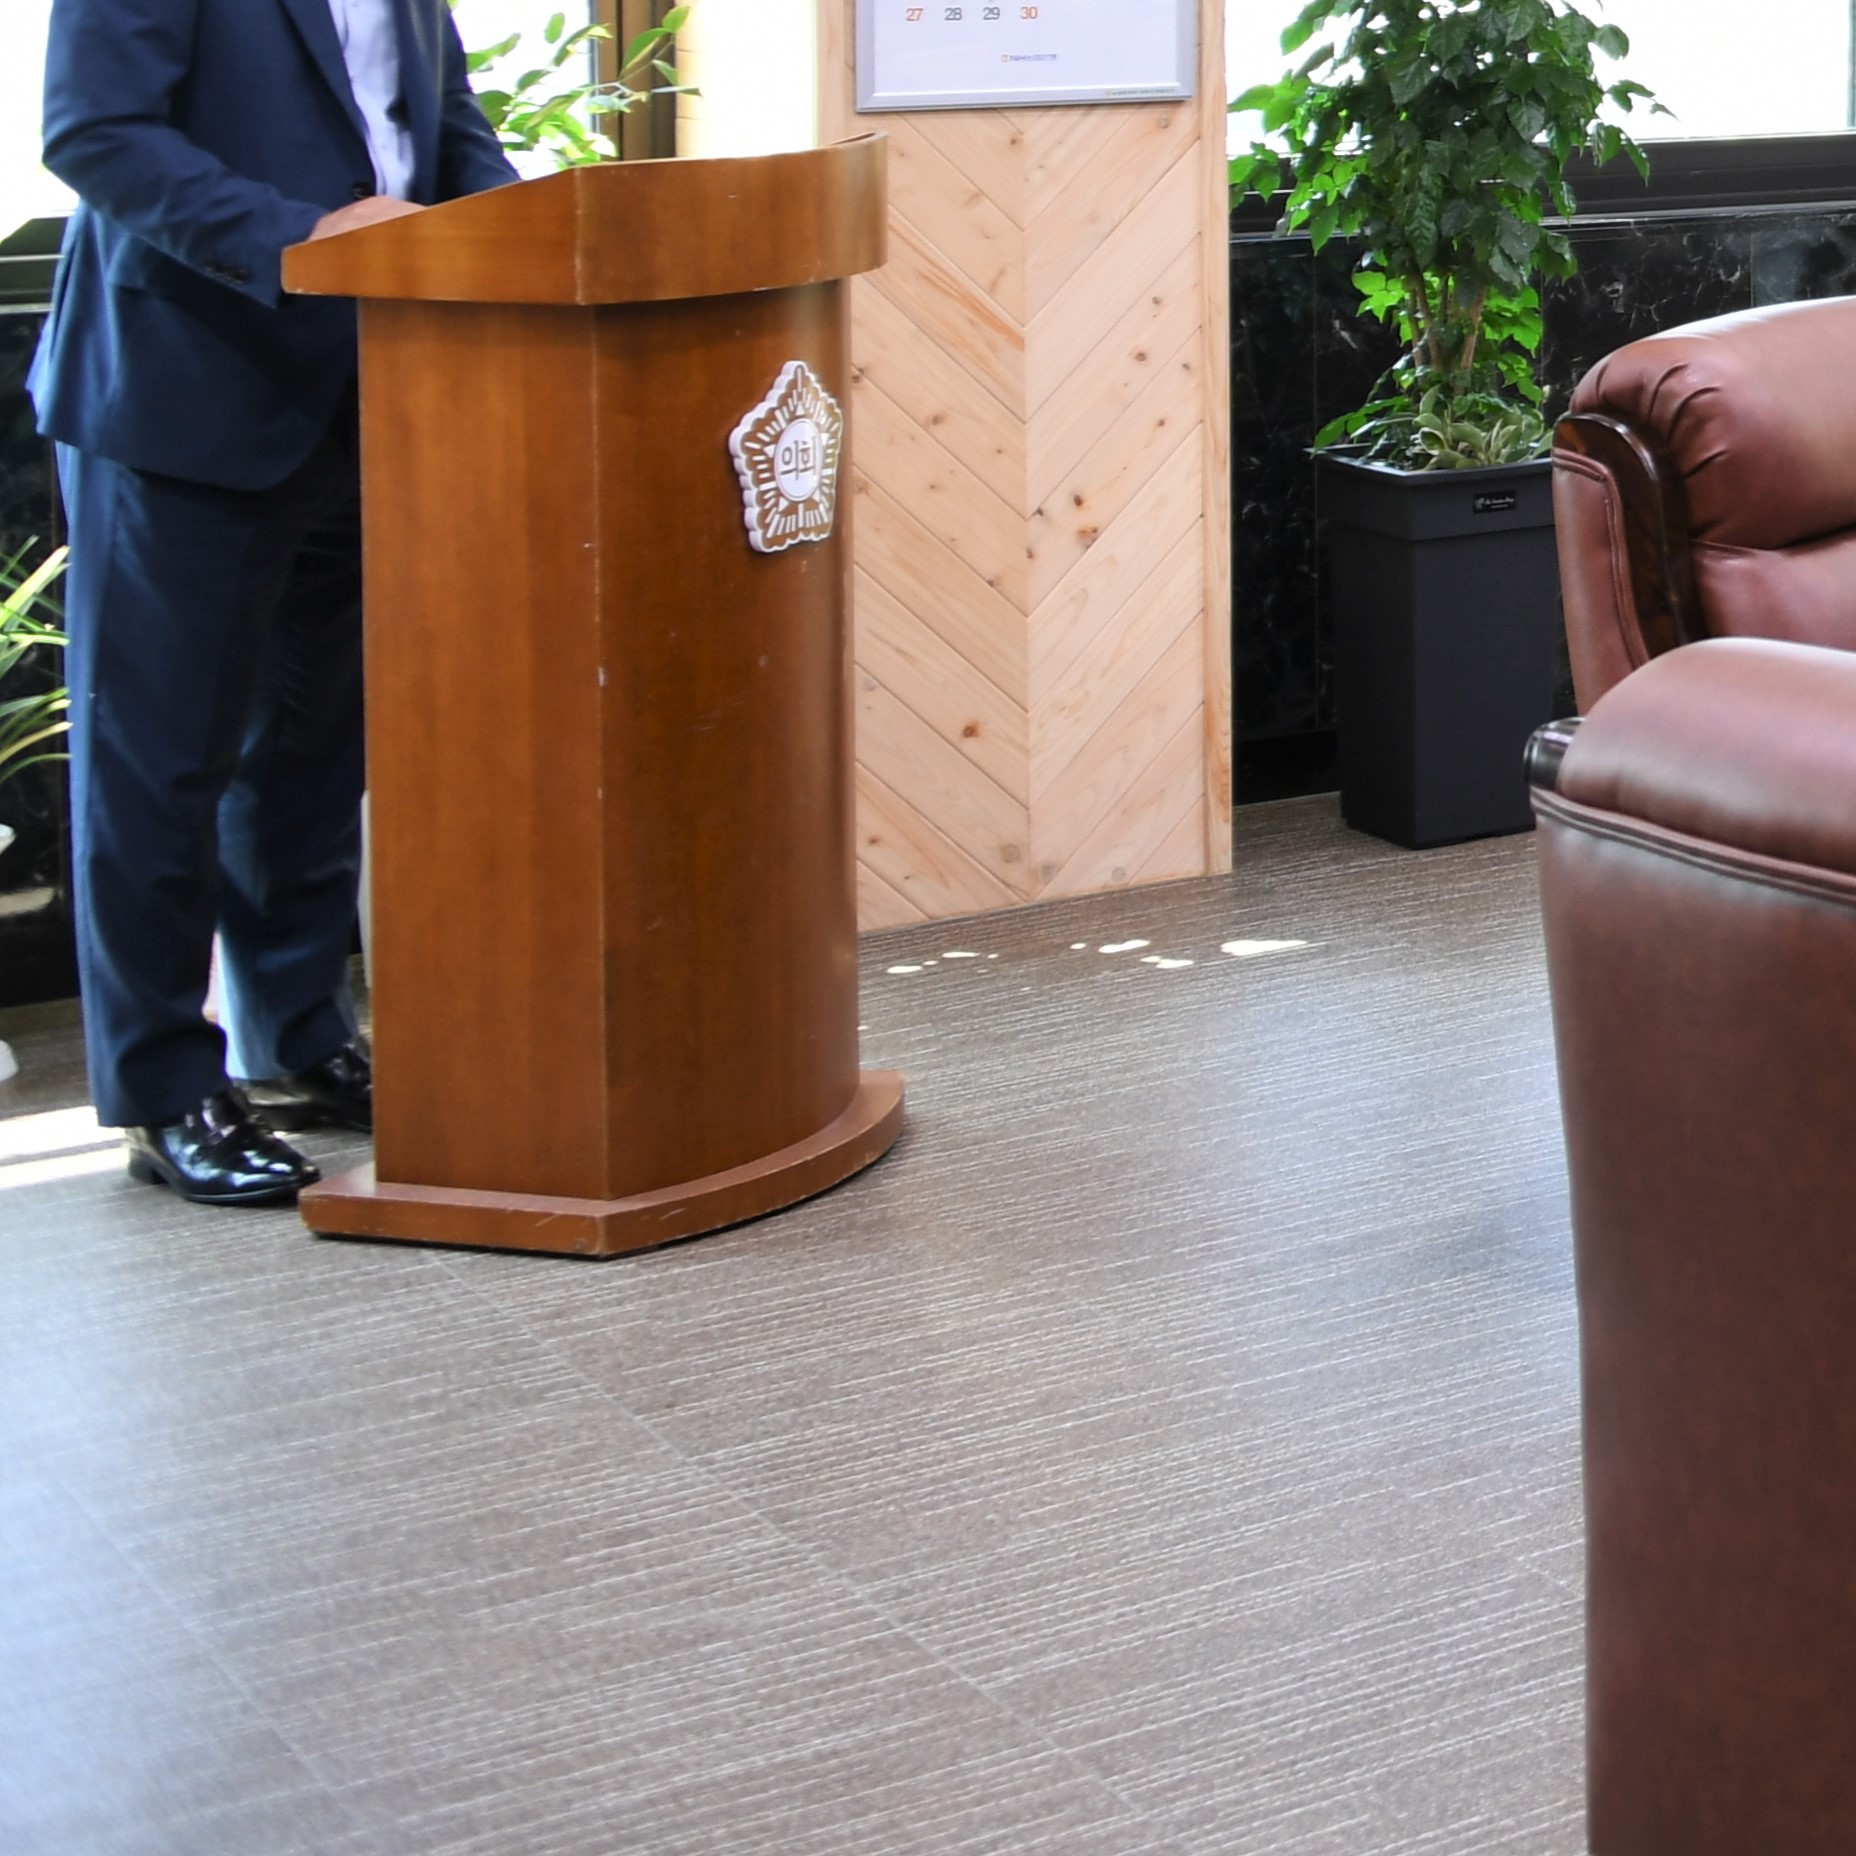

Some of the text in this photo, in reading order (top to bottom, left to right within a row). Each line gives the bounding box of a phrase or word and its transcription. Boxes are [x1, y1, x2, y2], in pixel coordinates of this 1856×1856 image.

[905, 5, 1039, 22] 27 28 29 30
